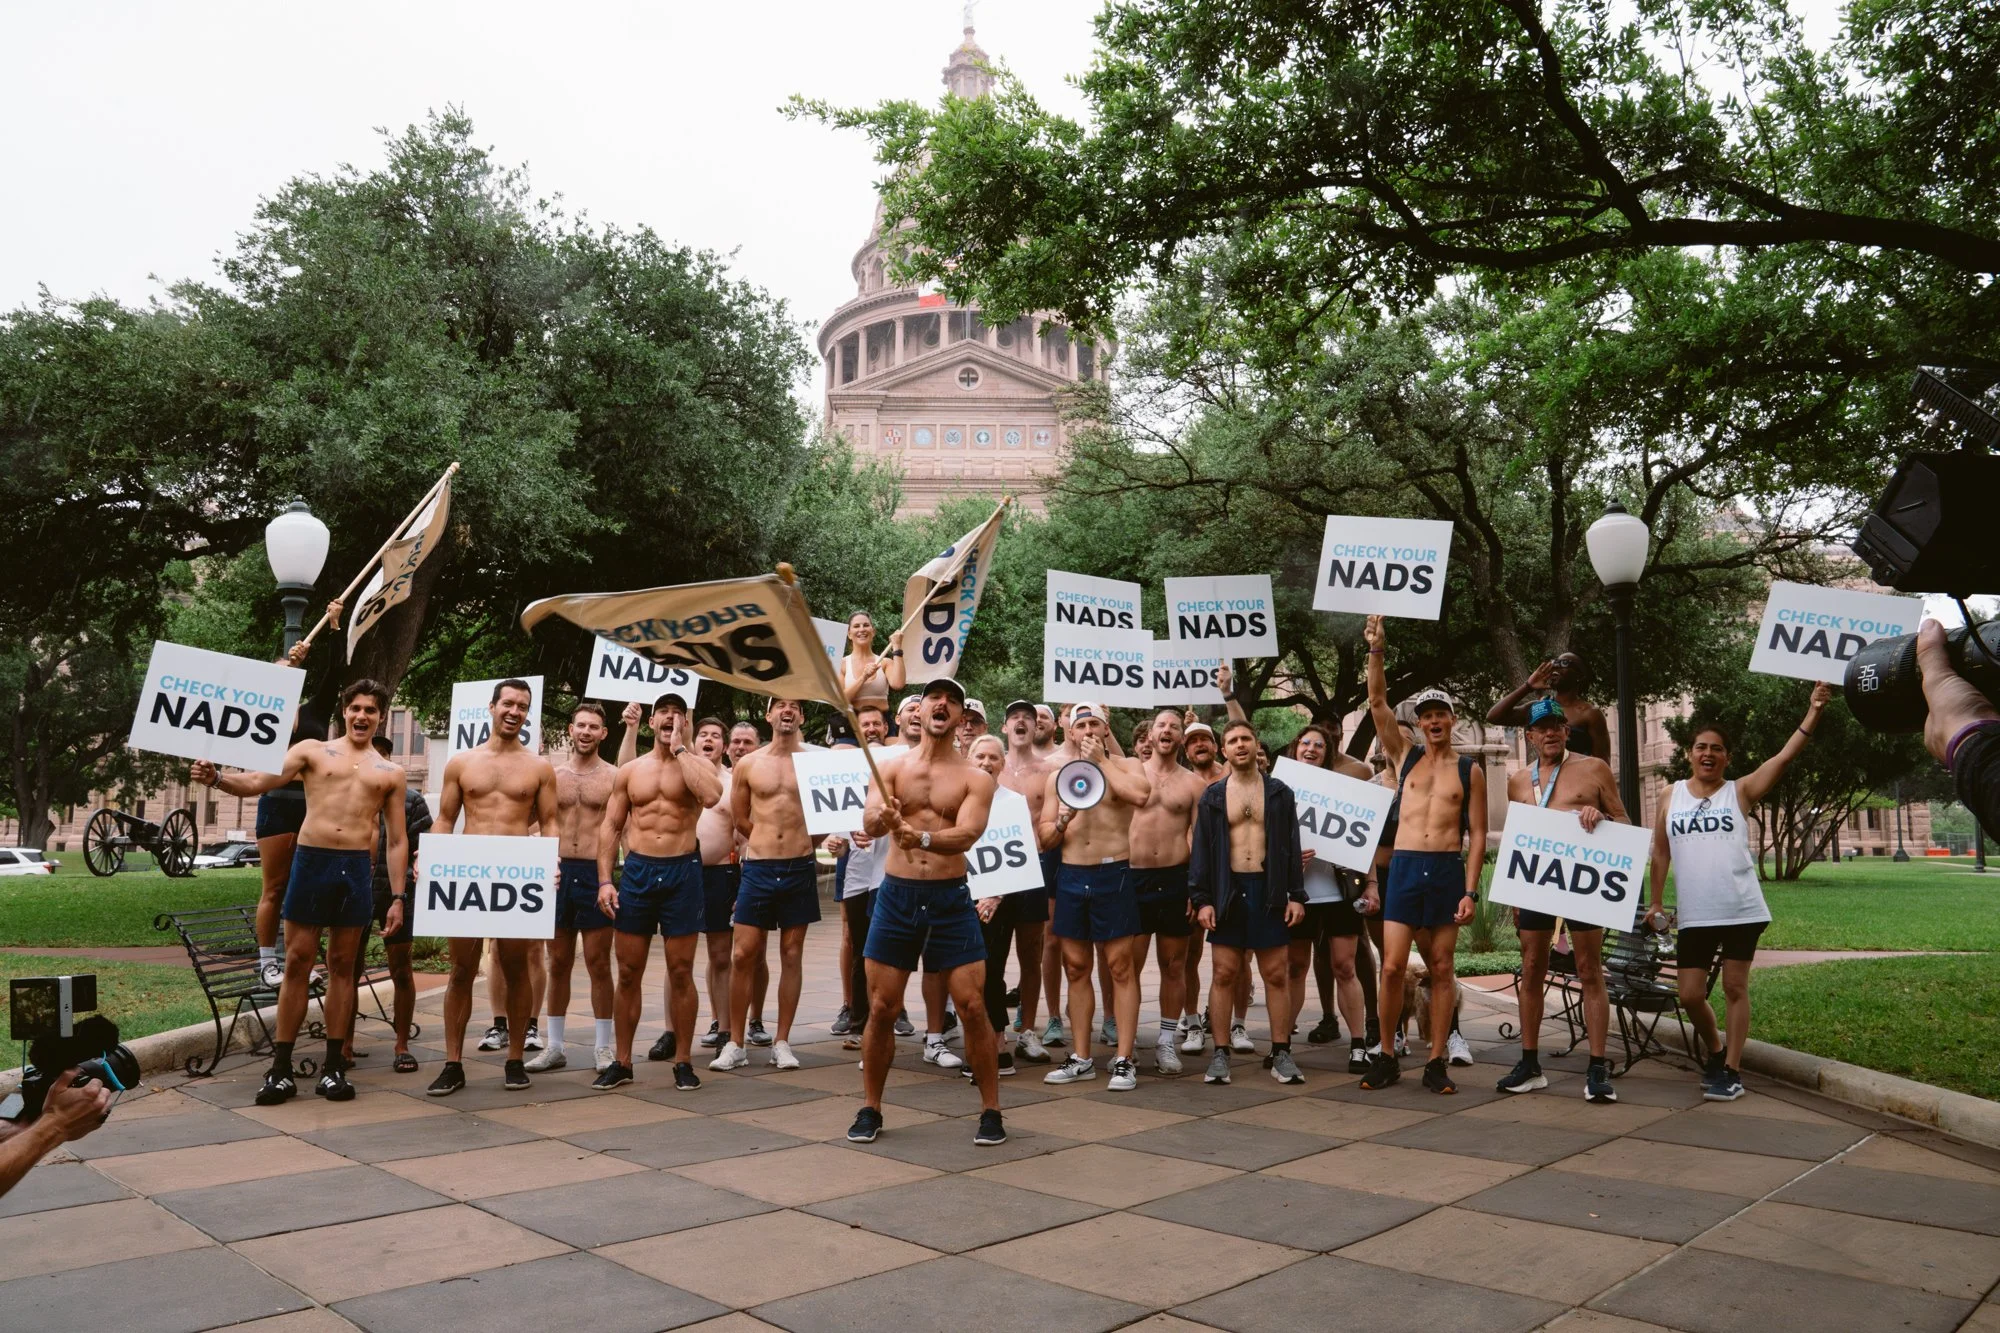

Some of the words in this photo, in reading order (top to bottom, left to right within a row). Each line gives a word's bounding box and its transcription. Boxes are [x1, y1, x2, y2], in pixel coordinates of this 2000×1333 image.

[1333, 544, 1388, 559] CHECK
[1391, 547, 1437, 562] YOUR
[1328, 559, 1434, 594] NADS
[1056, 590, 1097, 606] CHECK
[1100, 597, 1133, 611] YOUR
[1177, 600, 1224, 612] CHECK
[1227, 599, 1265, 611] YOUR
[1056, 602, 1134, 629] NADS
[1178, 612, 1267, 640] NADS
[1777, 608, 1843, 630] CHECK
[1847, 618, 1903, 637] YOUR
[1055, 647, 1103, 661] CHECK
[1106, 650, 1144, 663] YOUR
[1769, 623, 1868, 662] NAD
[1054, 660, 1144, 688] NADS
[1153, 658, 1191, 669] CHECK
[1857, 663, 1877, 679] 35
[160, 675, 228, 700] CHECK
[232, 688, 285, 712] YOUR
[1861, 676, 1879, 692] 80
[150, 692, 280, 745] NADS
[459, 707, 490, 721] CHEC
[456, 719, 532, 750] NAS
[808, 772, 861, 786] CHECK
[811, 785, 869, 813] NA
[1334, 799, 1376, 821] YOUR
[1706, 807, 1733, 816] YOUR
[1297, 806, 1371, 848] ADS
[1671, 815, 1734, 837] NADS
[967, 840, 1027, 876] DS
[1515, 834, 1577, 858] CHECK
[1582, 847, 1633, 870] YOUR
[430, 864, 491, 879] CHECK
[495, 866, 545, 880] YOUR
[1507, 850, 1628, 902] NADS
[428, 881, 544, 913] NADS
